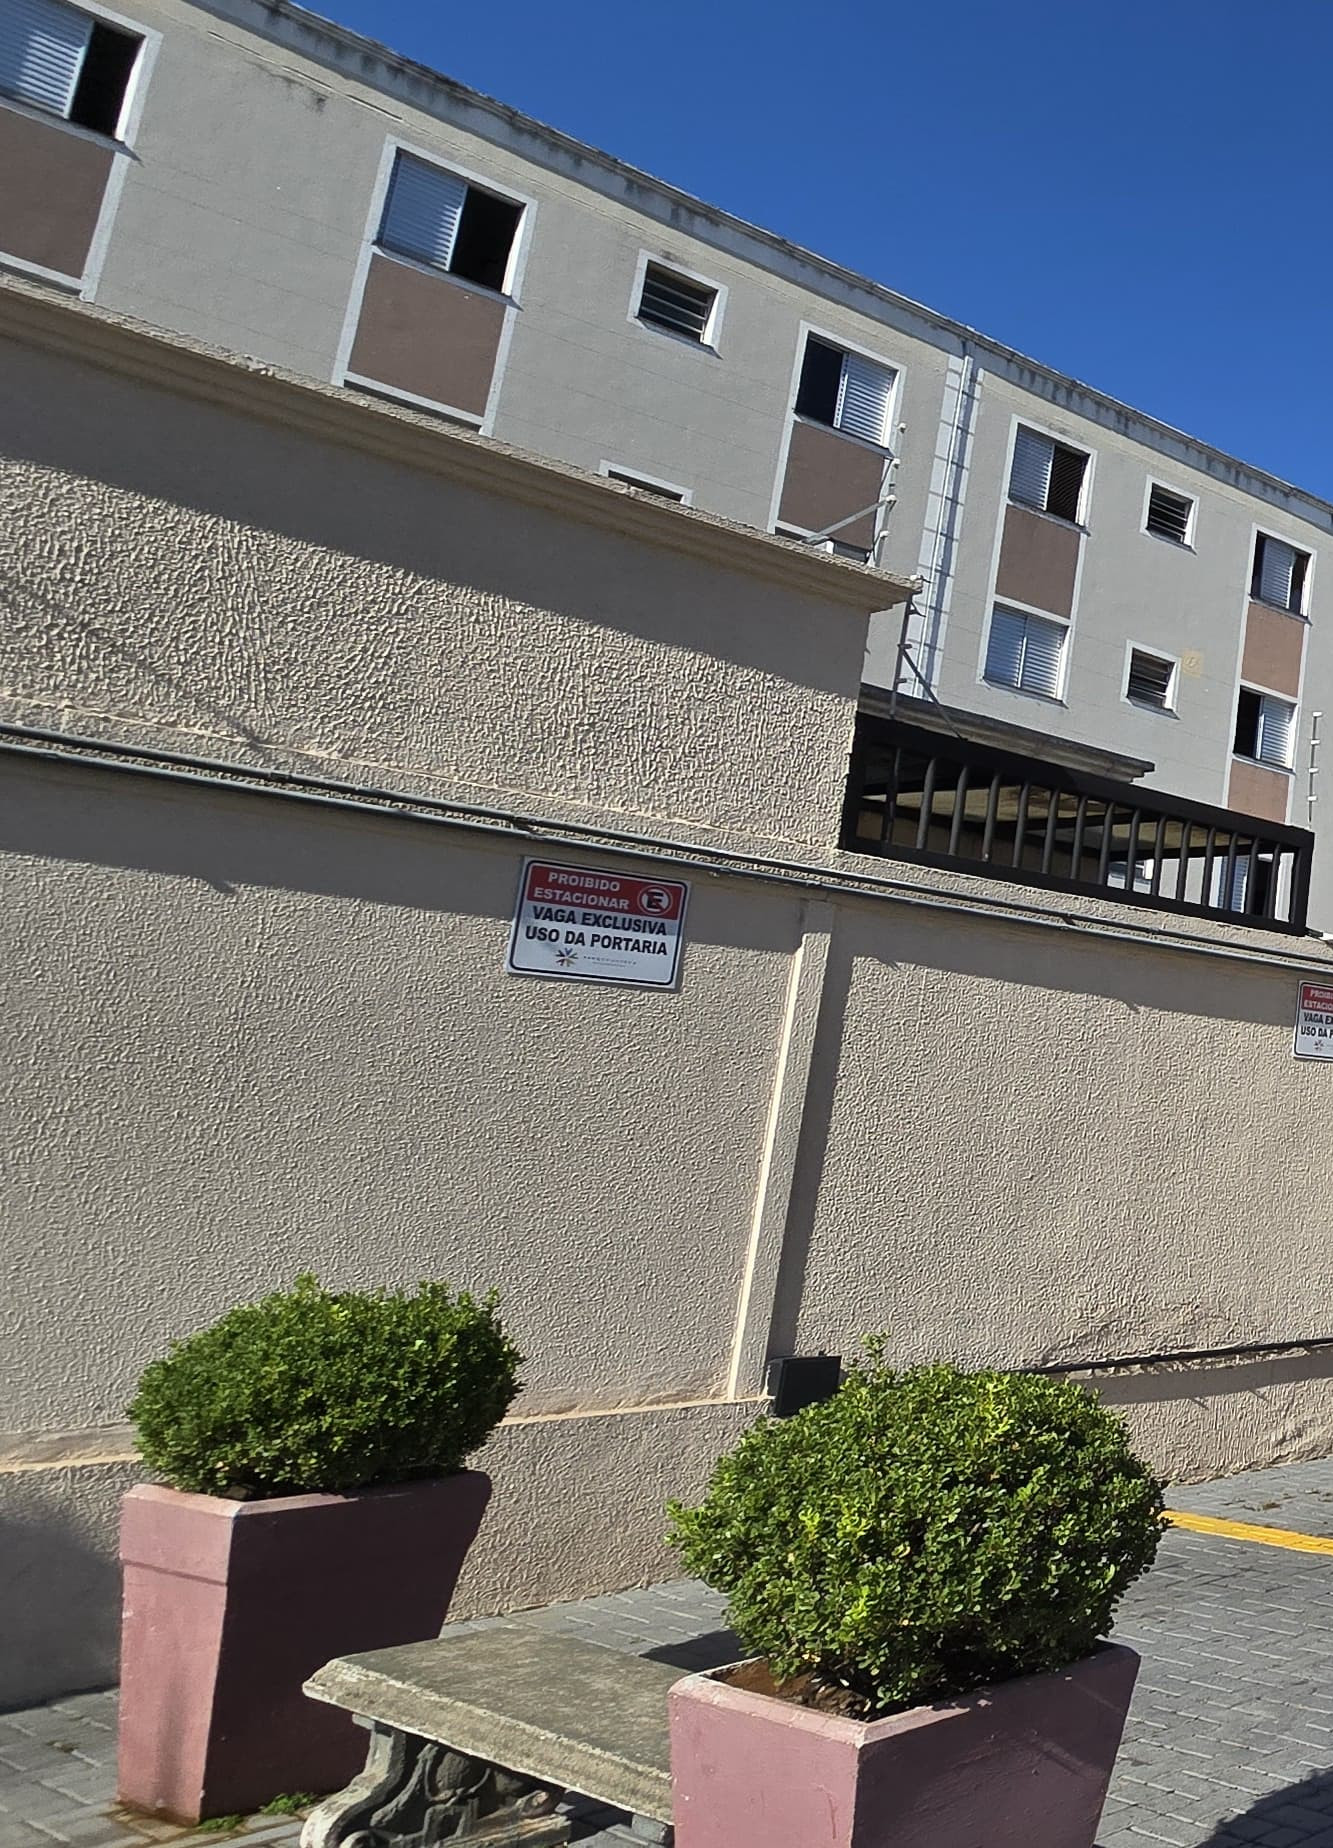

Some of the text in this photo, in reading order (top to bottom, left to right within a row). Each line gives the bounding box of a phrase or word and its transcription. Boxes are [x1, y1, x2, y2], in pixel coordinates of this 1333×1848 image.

[547, 871, 620, 892] PROIBIDO
[533, 887, 630, 910] ESTACIONAR
[532, 905, 667, 936] VAGA EXCLUSIVA
[525, 925, 668, 956] USO DA PORTARIA
[1303, 1012, 1324, 1025] VAGA
[1300, 1026, 1317, 1037] USO
[1318, 1027, 1328, 1038] DA
